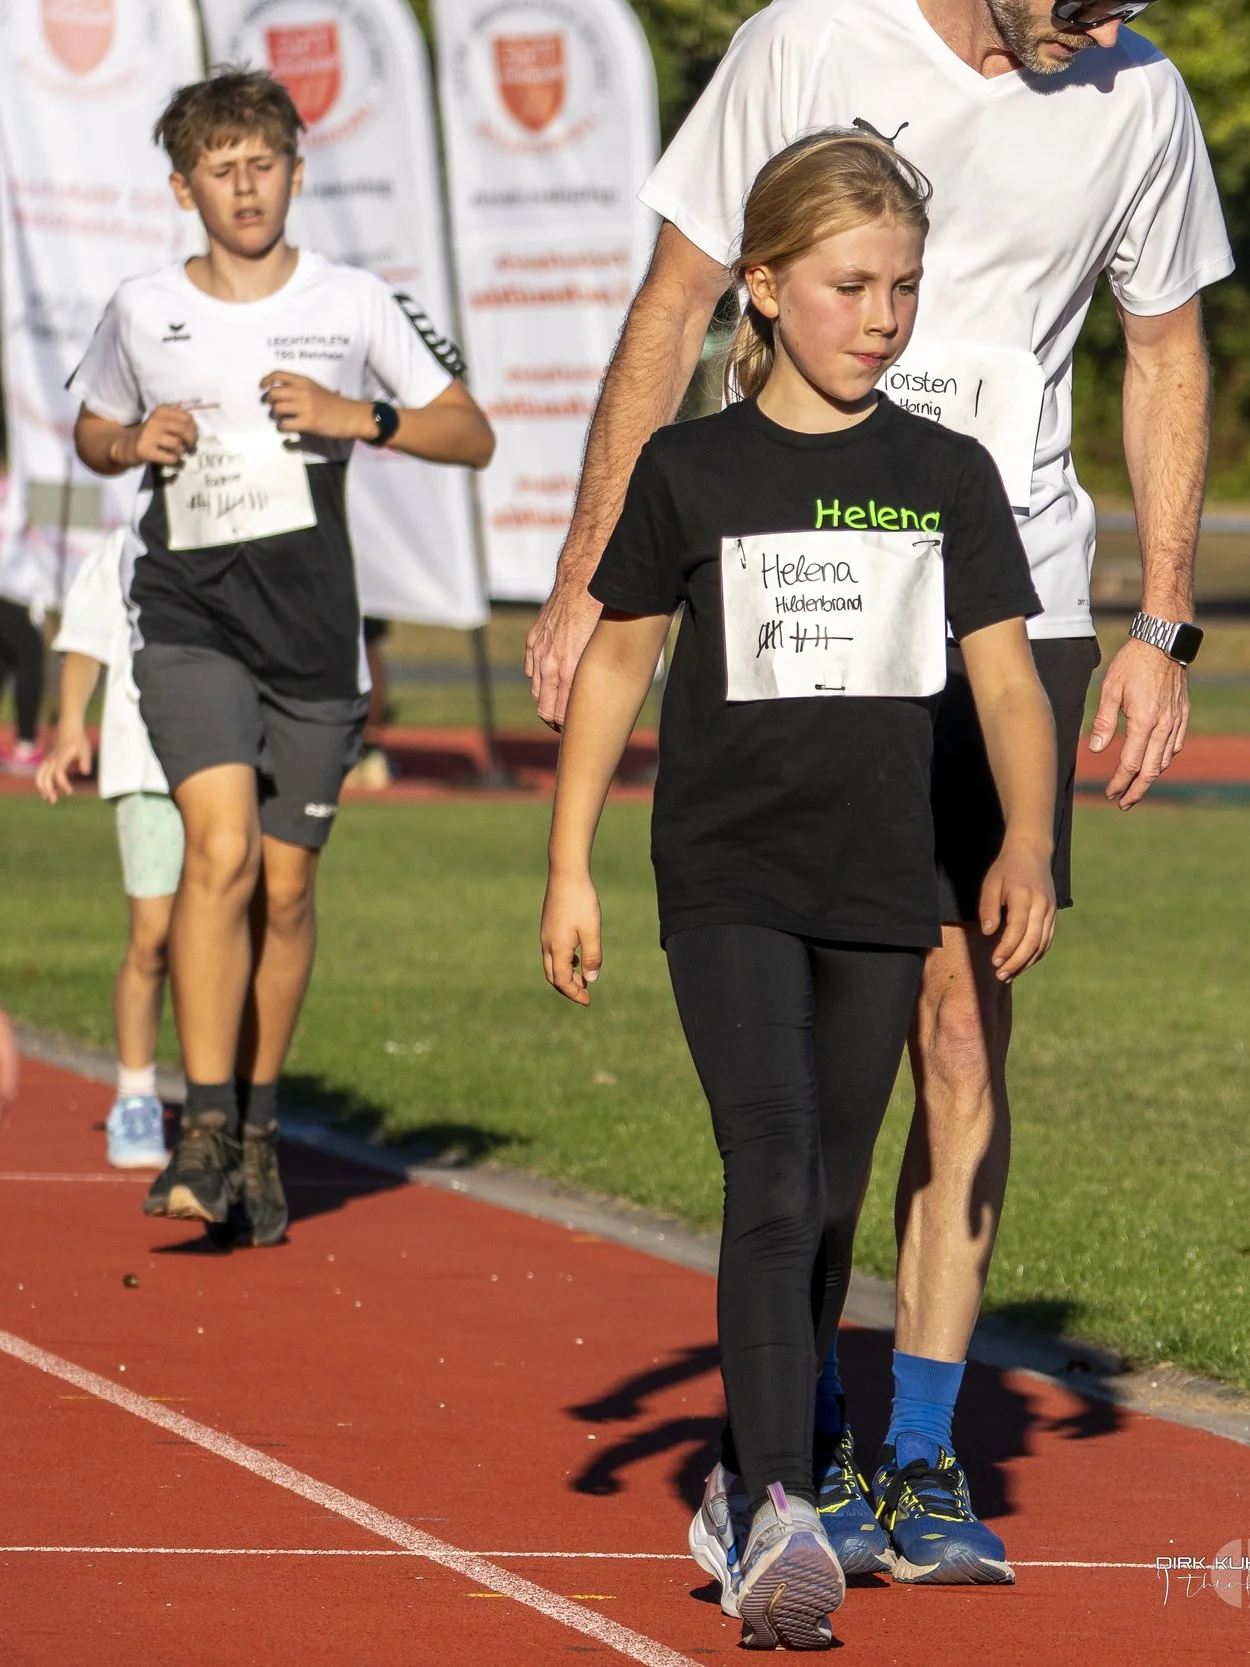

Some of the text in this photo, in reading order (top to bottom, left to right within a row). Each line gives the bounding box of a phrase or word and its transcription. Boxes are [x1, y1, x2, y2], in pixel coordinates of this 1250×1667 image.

[900, 398, 942, 422] Hornig
[815, 499, 941, 533] Helena
[761, 552, 859, 589] Helena
